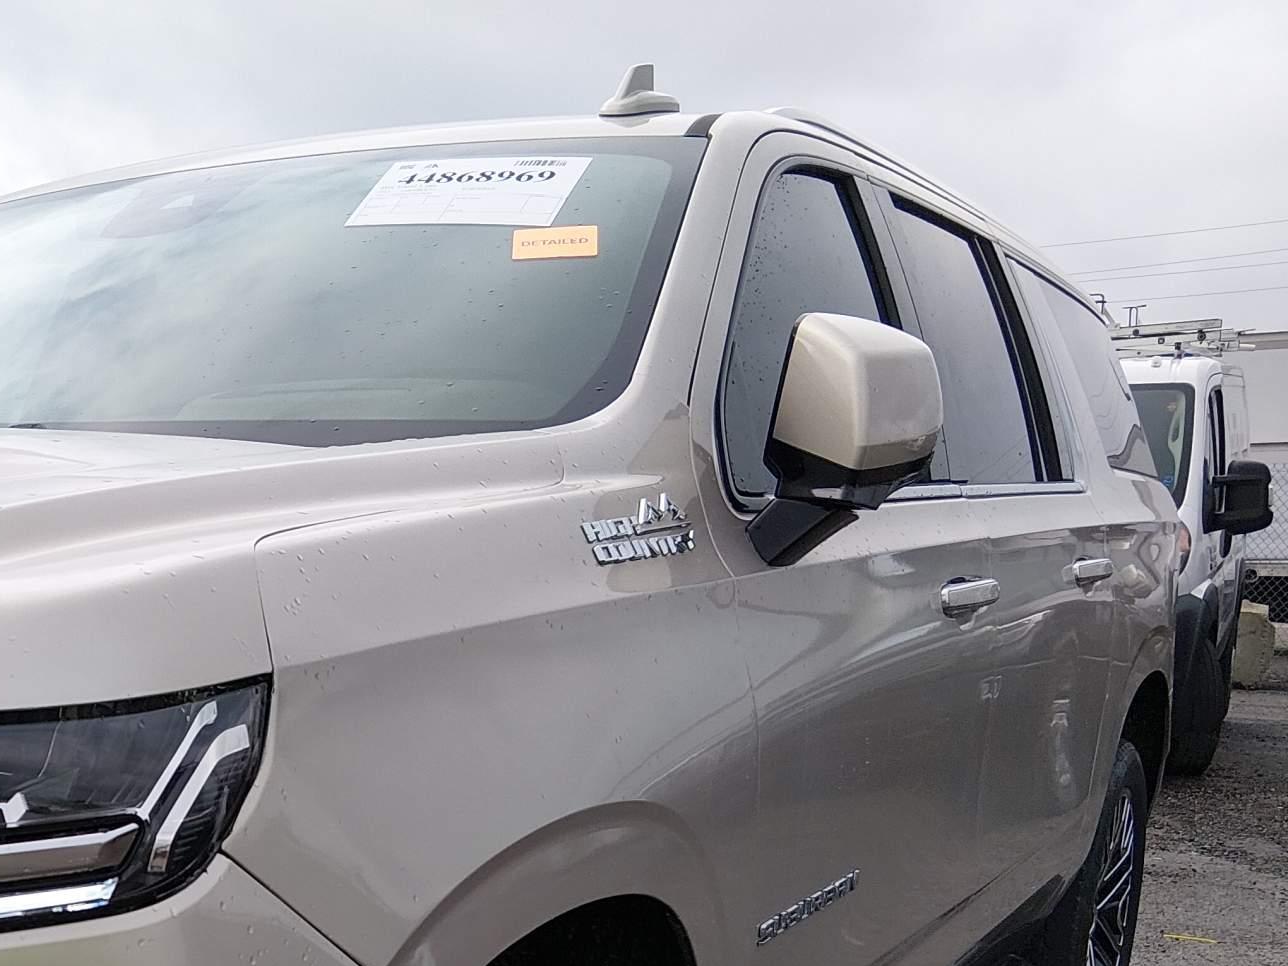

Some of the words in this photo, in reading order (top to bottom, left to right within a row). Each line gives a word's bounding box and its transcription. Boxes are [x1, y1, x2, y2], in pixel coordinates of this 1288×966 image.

[399, 170, 557, 185] 44868969
[521, 237, 589, 247] DETAILED
[757, 869, 860, 945] SUBURBAN
